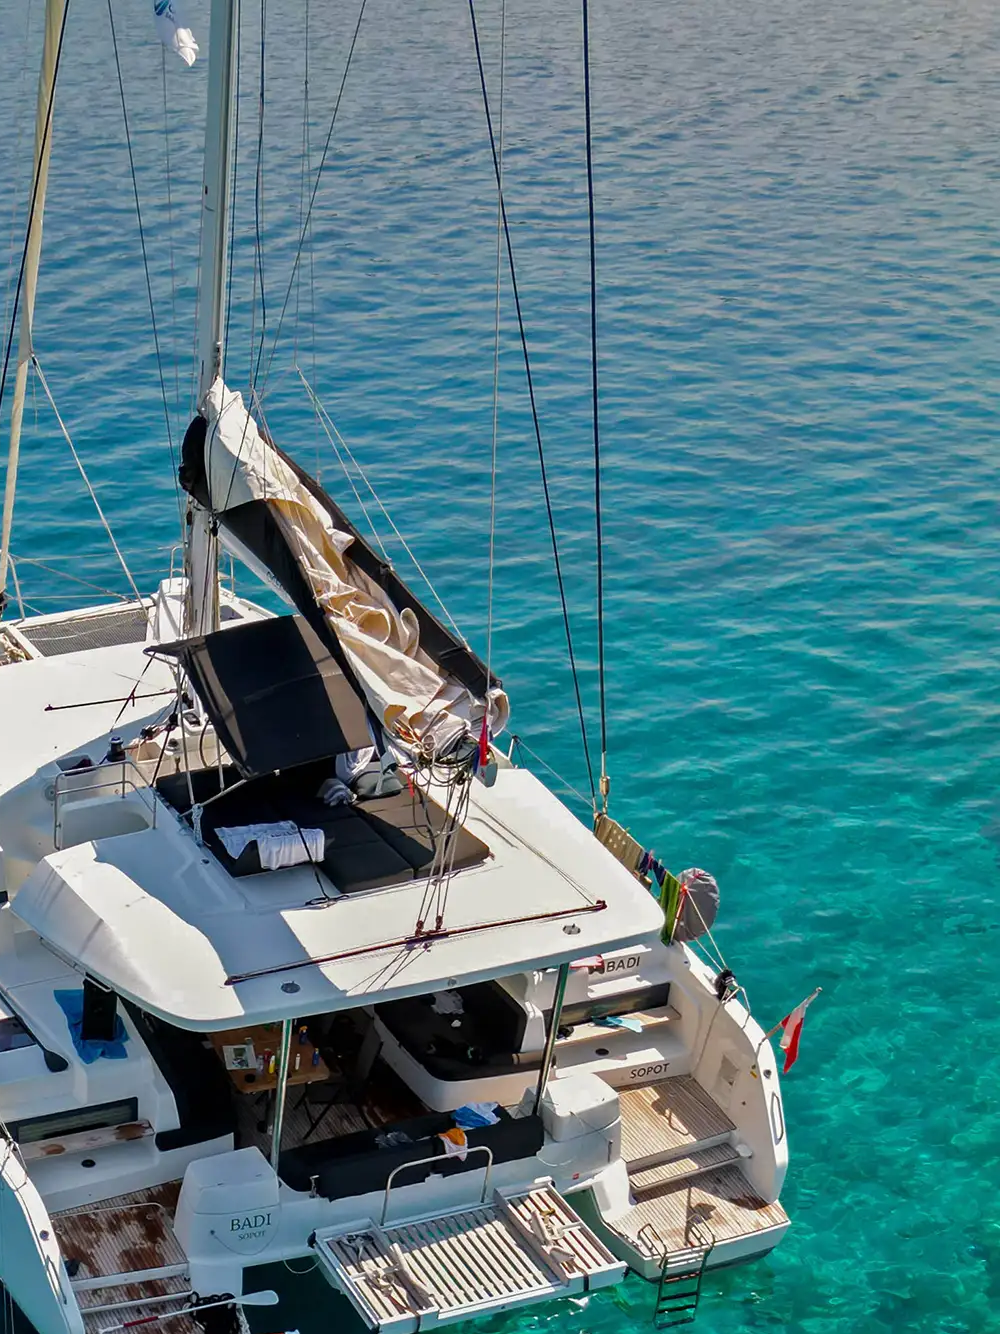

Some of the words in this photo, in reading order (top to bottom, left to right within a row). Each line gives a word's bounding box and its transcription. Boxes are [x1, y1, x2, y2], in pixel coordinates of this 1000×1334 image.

[606, 956, 641, 973] BADI
[630, 1062, 670, 1079] SOPOT
[230, 1212, 272, 1232] BADI
[238, 1230, 266, 1241] SOPOT
